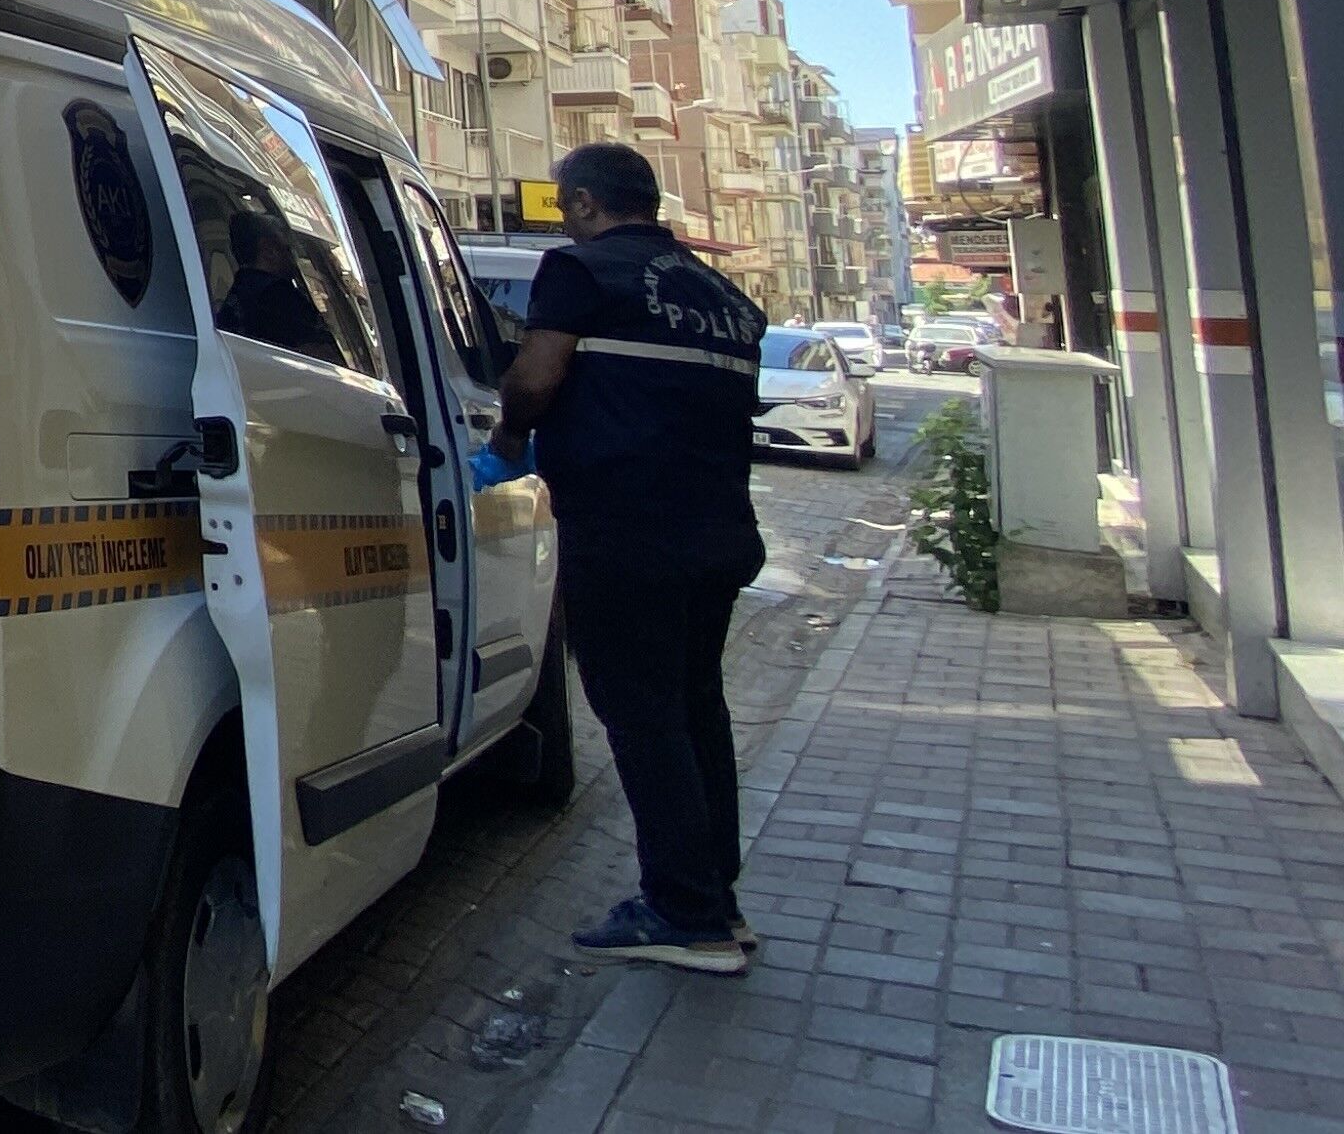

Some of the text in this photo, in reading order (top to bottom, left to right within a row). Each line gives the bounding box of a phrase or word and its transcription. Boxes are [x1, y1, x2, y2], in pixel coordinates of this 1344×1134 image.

[24, 533, 169, 579] OLAY YERİ İNCELEME
